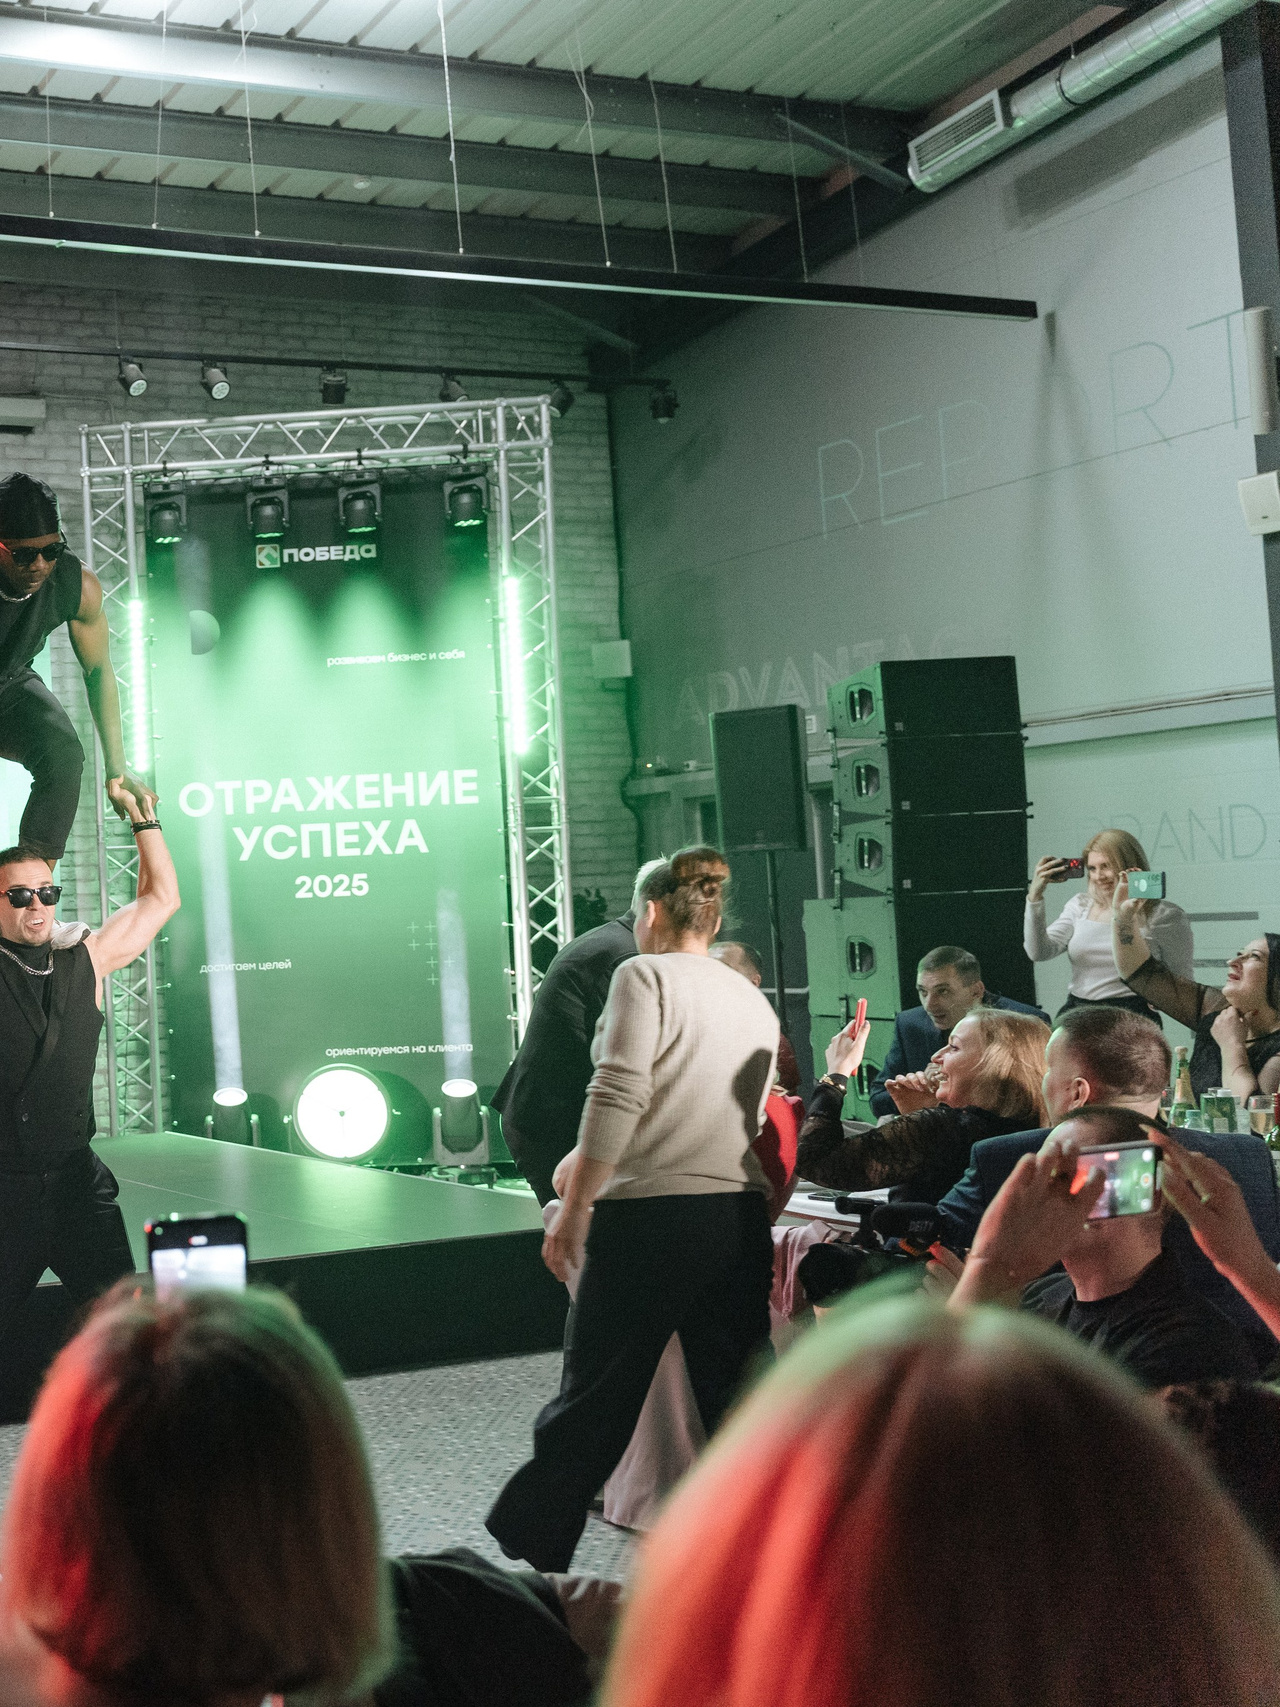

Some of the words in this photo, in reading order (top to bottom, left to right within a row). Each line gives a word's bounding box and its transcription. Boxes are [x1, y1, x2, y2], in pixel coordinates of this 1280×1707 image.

[816, 308, 1248, 540] REPRT
[387, 652, 428, 663] бизнес
[429, 652, 436, 660] и
[438, 649, 466, 660] себя
[178, 768, 480, 818] ОТРАЖЕНИЕ
[232, 818, 430, 861] УСПЕХА
[294, 873, 370, 899] 2025
[199, 962, 257, 974] достигаем
[258, 959, 292, 971] целей
[325, 1045, 410, 1058] ориентируемся
[411, 1044, 426, 1054] на
[428, 1043, 474, 1053] клиента
